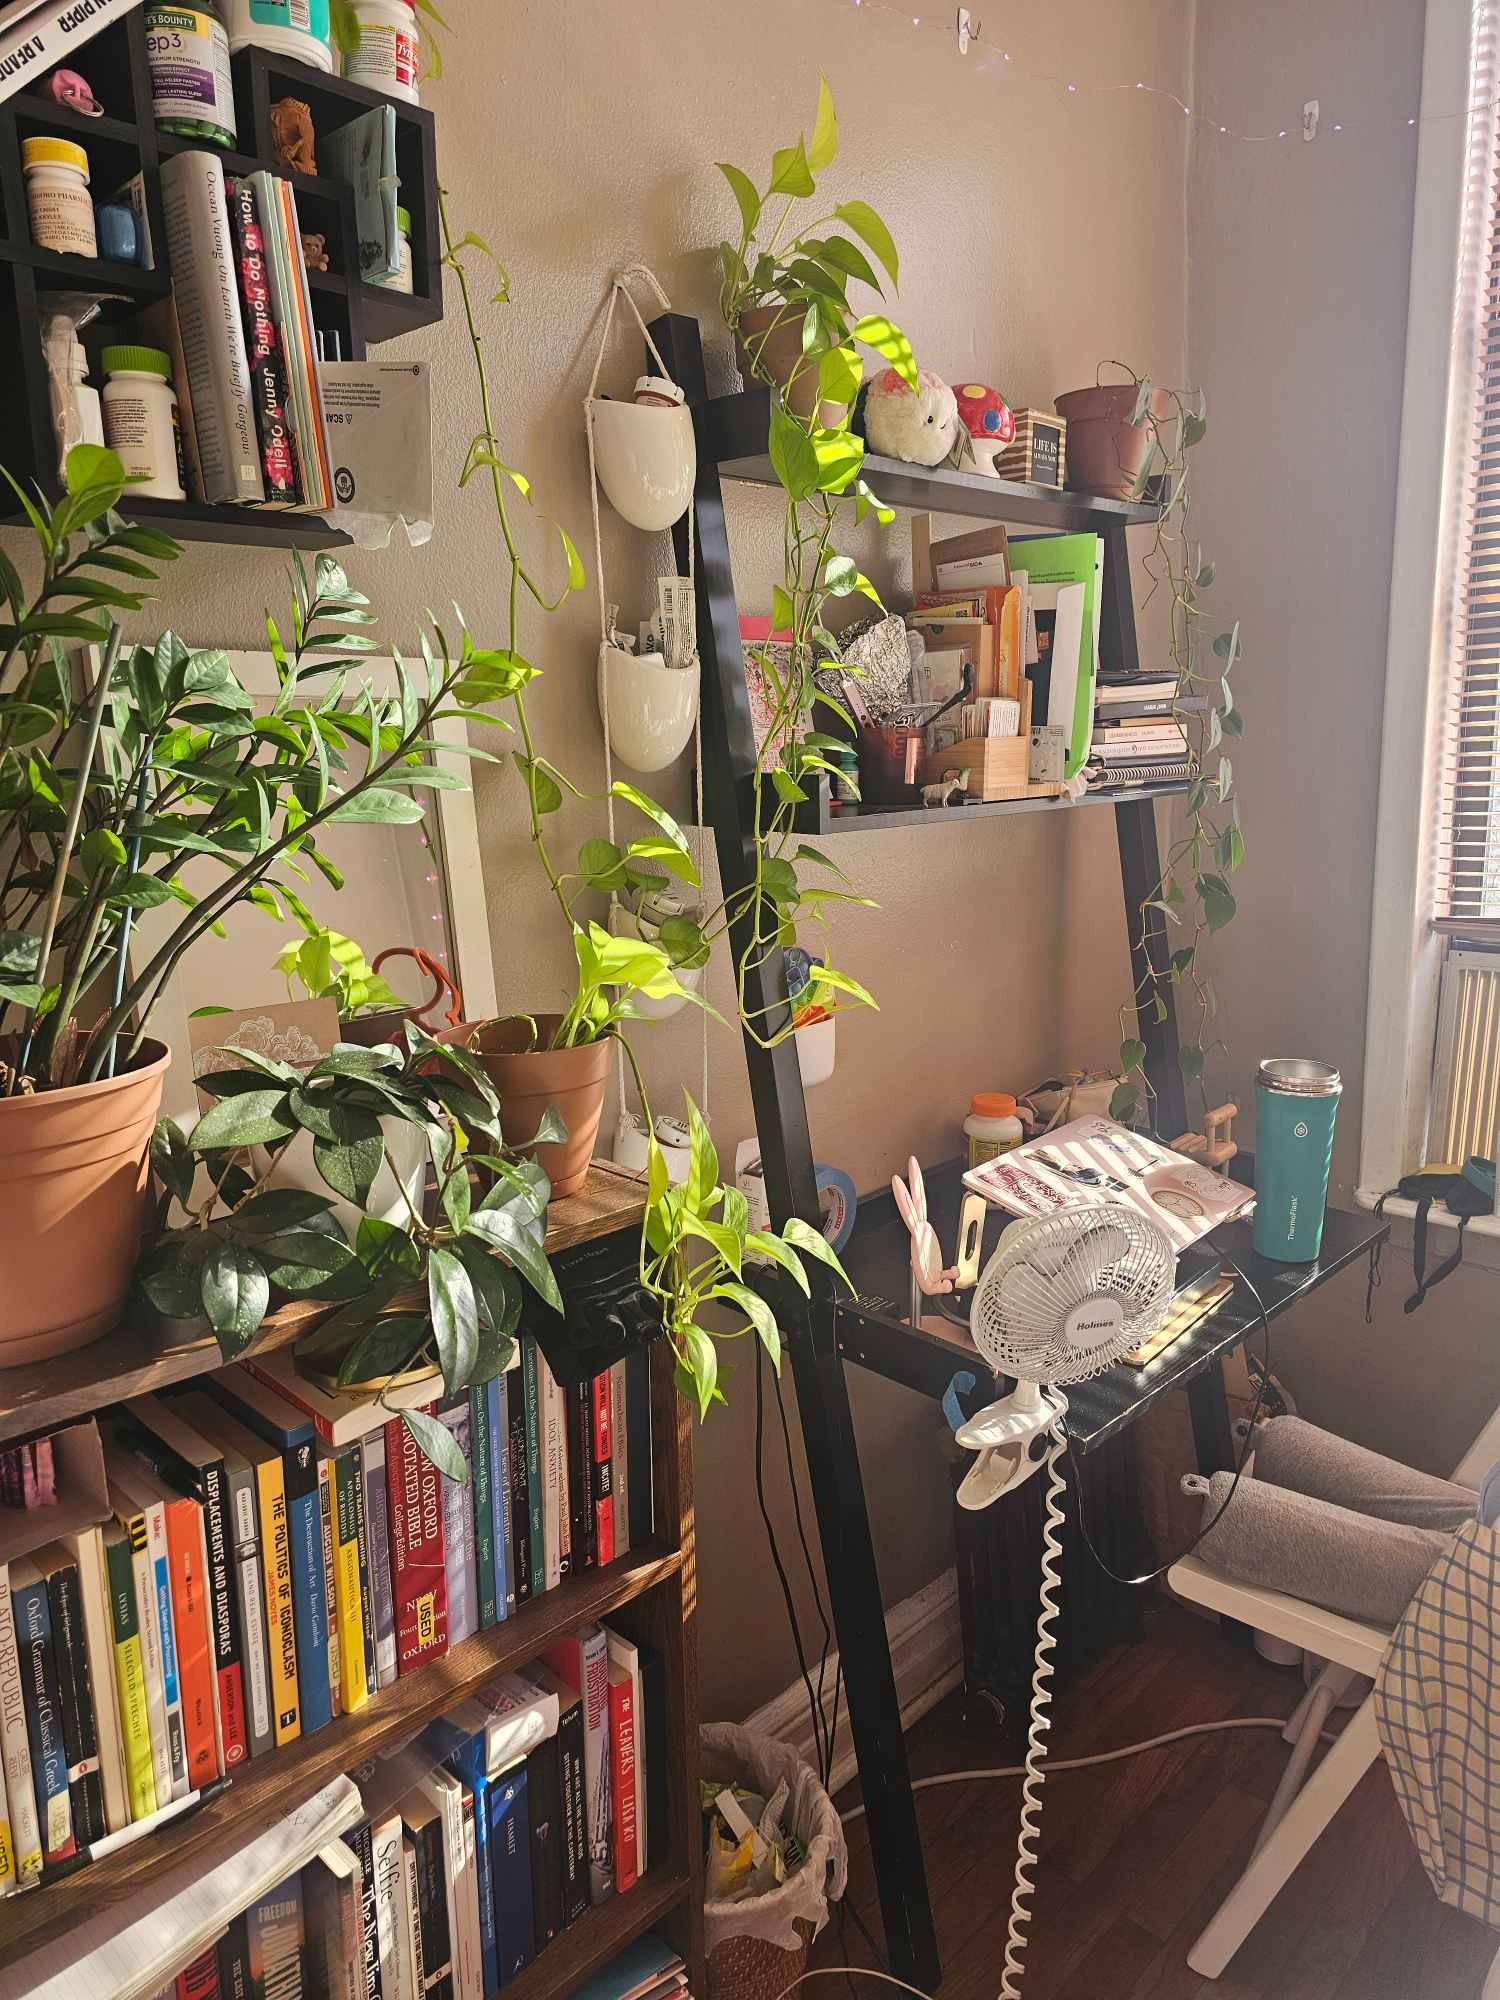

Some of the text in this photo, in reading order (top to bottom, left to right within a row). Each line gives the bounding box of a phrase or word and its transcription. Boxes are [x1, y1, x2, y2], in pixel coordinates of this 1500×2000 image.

[158, 15, 194, 27] BOUNTY
[206, 171, 225, 259] Ocean Vuong
[218, 265, 228, 282] On
[241, 189, 272, 356] How to Do Nothing
[221, 286, 232, 321] Earth
[229, 360, 244, 401] Briefly
[235, 404, 250, 456] Gorgeous
[263, 367, 288, 469] Jenny Odell
[1288, 1197, 1298, 1241] ThermoFlask
[1077, 1320, 1114, 1331] Holmes
[528, 1385, 536, 1396] On
[477, 1410, 485, 1421] On
[478, 1423, 486, 1438] the
[529, 1412, 537, 1438] Nature
[500, 1447, 509, 1473] Uses
[548, 1418, 557, 1489] IDOL ANXIETY
[303, 1499, 313, 1516] The
[346, 1480, 356, 1535] APOLLONIUS
[355, 1493, 363, 1525] TRAINS
[422, 1475, 438, 1540] OXFORD
[480, 1474, 488, 1503] Things
[339, 1490, 349, 1540] OF RHODES
[407, 1506, 422, 1550] BIBLE
[502, 1489, 512, 1543] Literature
[305, 1516, 316, 1562] Destruction
[323, 1524, 334, 1562] AUGUST
[358, 1527, 367, 1567] RUNNING
[394, 1504, 407, 1571] College Edition
[465, 1541, 474, 1561] the
[207, 1470, 232, 1656] DISPLACEMENTS AND DIASPORAS
[308, 1574, 317, 1589] Art
[271, 1493, 296, 1680] THE POLITICS OF ICONOCLASM
[325, 1564, 337, 1608] WILSON
[420, 1601, 431, 1638] USED
[124, 1643, 137, 1690] SELECTED
[403, 1633, 446, 1660] OXFORD
[27, 1597, 61, 1796] Oxford Grammar of Classical Greek
[586, 1660, 601, 1732] FRUSTRATION
[619, 1718, 635, 1776] LEAVERS
[621, 1795, 634, 1842] LISA KO
[362, 1828, 372, 1875] MICHELLE
[377, 1839, 400, 1905] Selfie
[258, 1899, 298, 1923] FREEDOM
[361, 1884, 381, 1990] The New Jim
